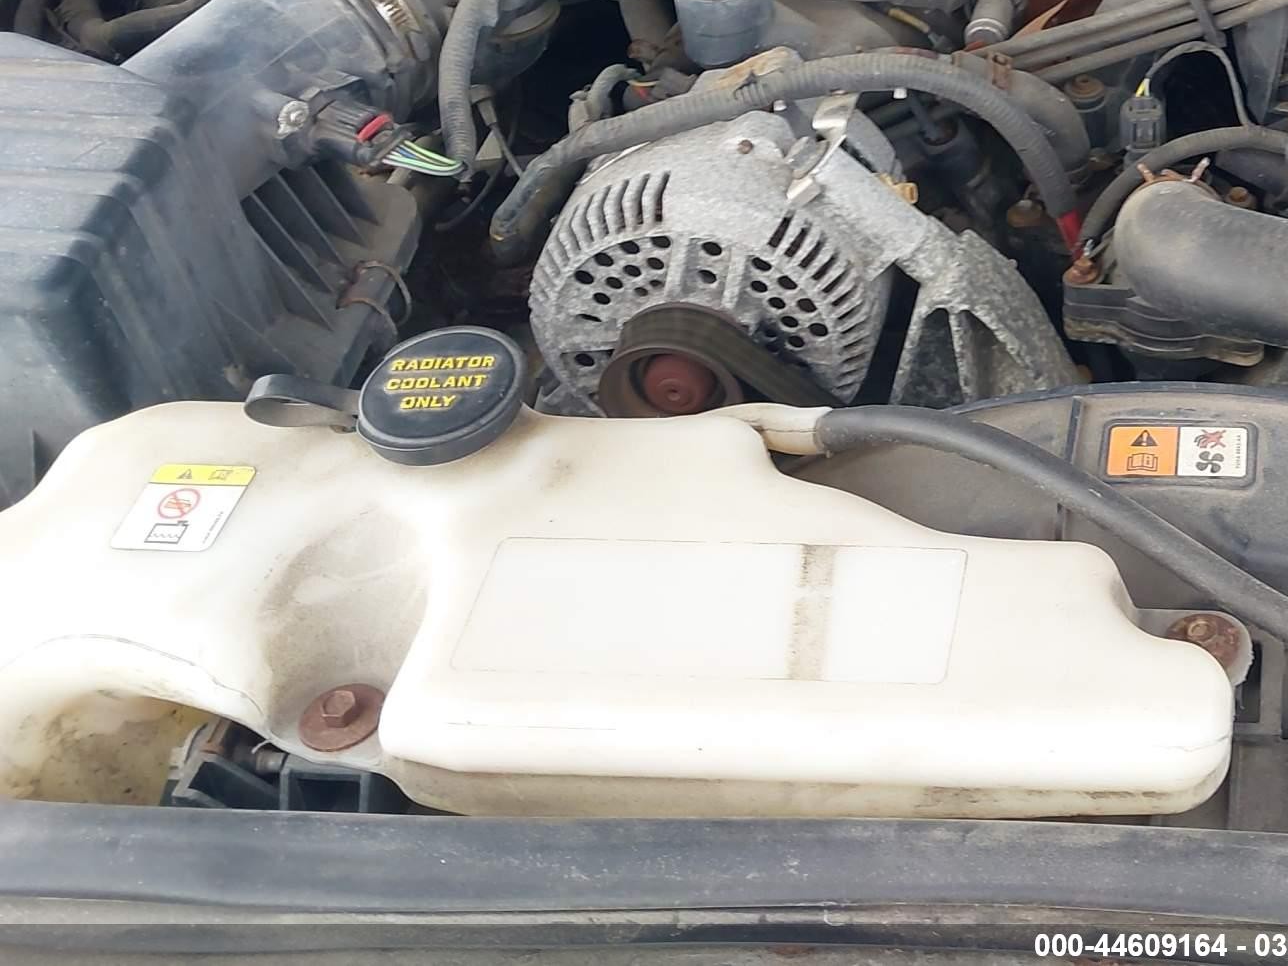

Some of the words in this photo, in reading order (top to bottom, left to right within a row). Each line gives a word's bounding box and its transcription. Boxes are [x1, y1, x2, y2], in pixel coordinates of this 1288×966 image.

[391, 356, 495, 371] RADIATOR
[386, 374, 487, 390] COOLANT
[399, 395, 456, 409] ONLY
